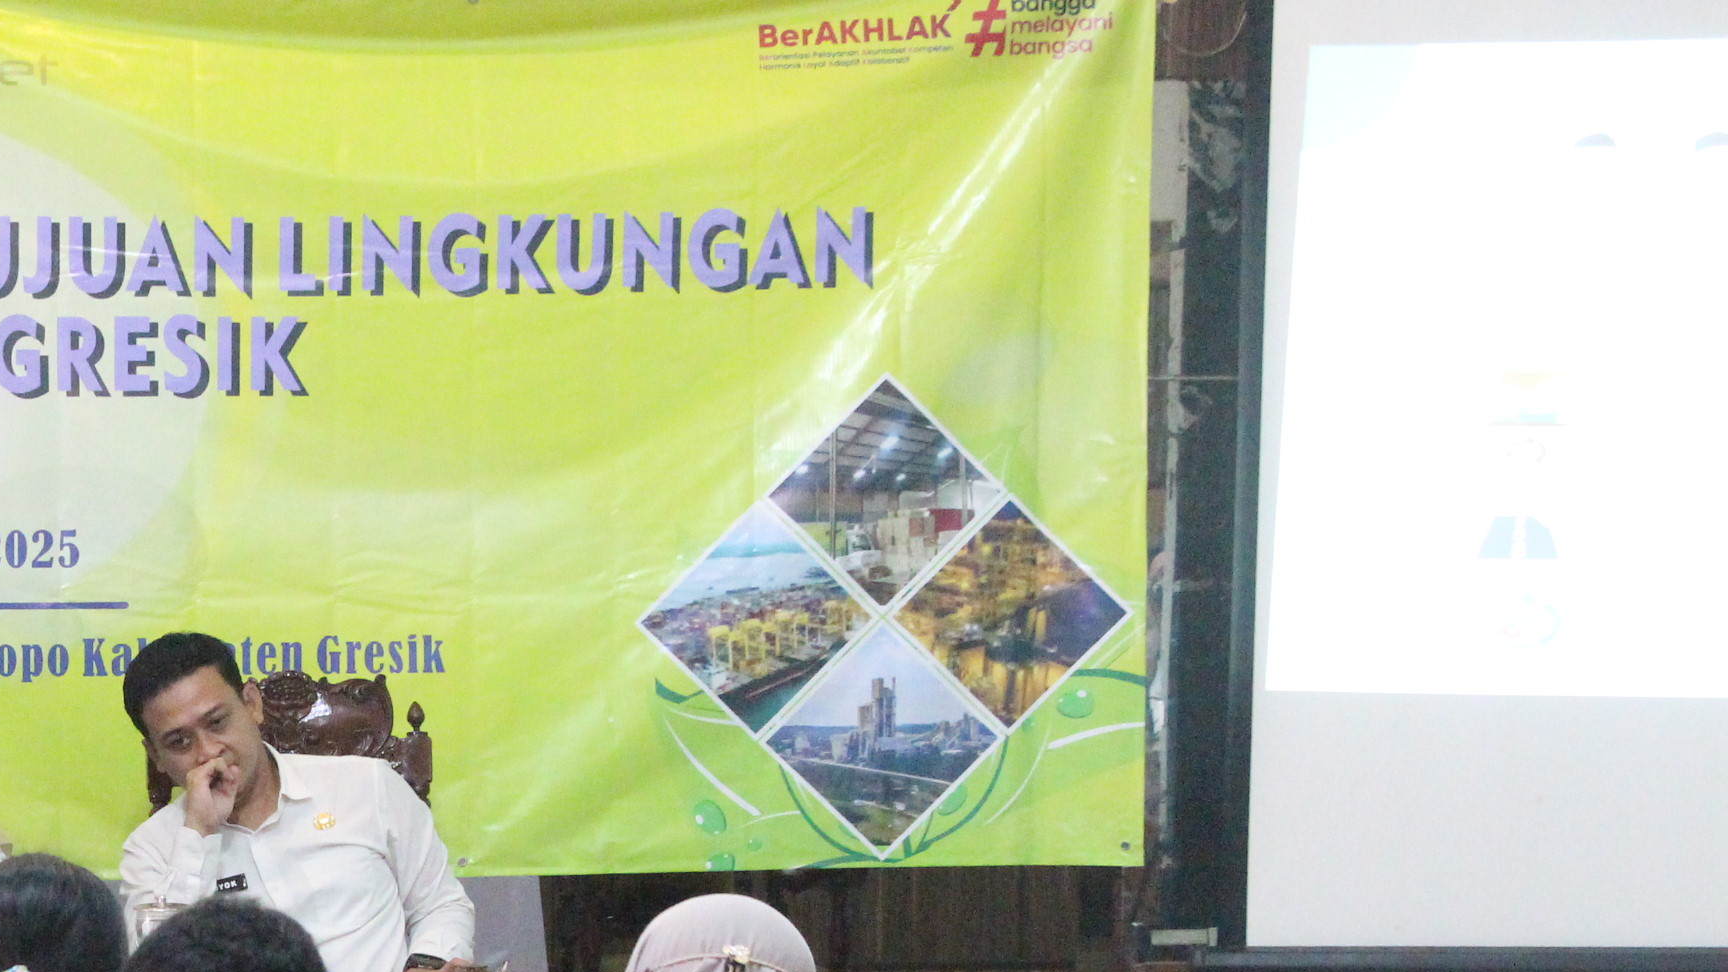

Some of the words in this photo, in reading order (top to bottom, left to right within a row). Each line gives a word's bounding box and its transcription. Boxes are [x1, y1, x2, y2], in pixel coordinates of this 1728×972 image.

[758, 13, 953, 48] BerAKHLAK
[1010, 12, 1114, 37] melayani
[1010, 39, 1094, 59] bangsa
[278, 206, 875, 298] LINGKUNGAN
[316, 636, 446, 676] Gresik
